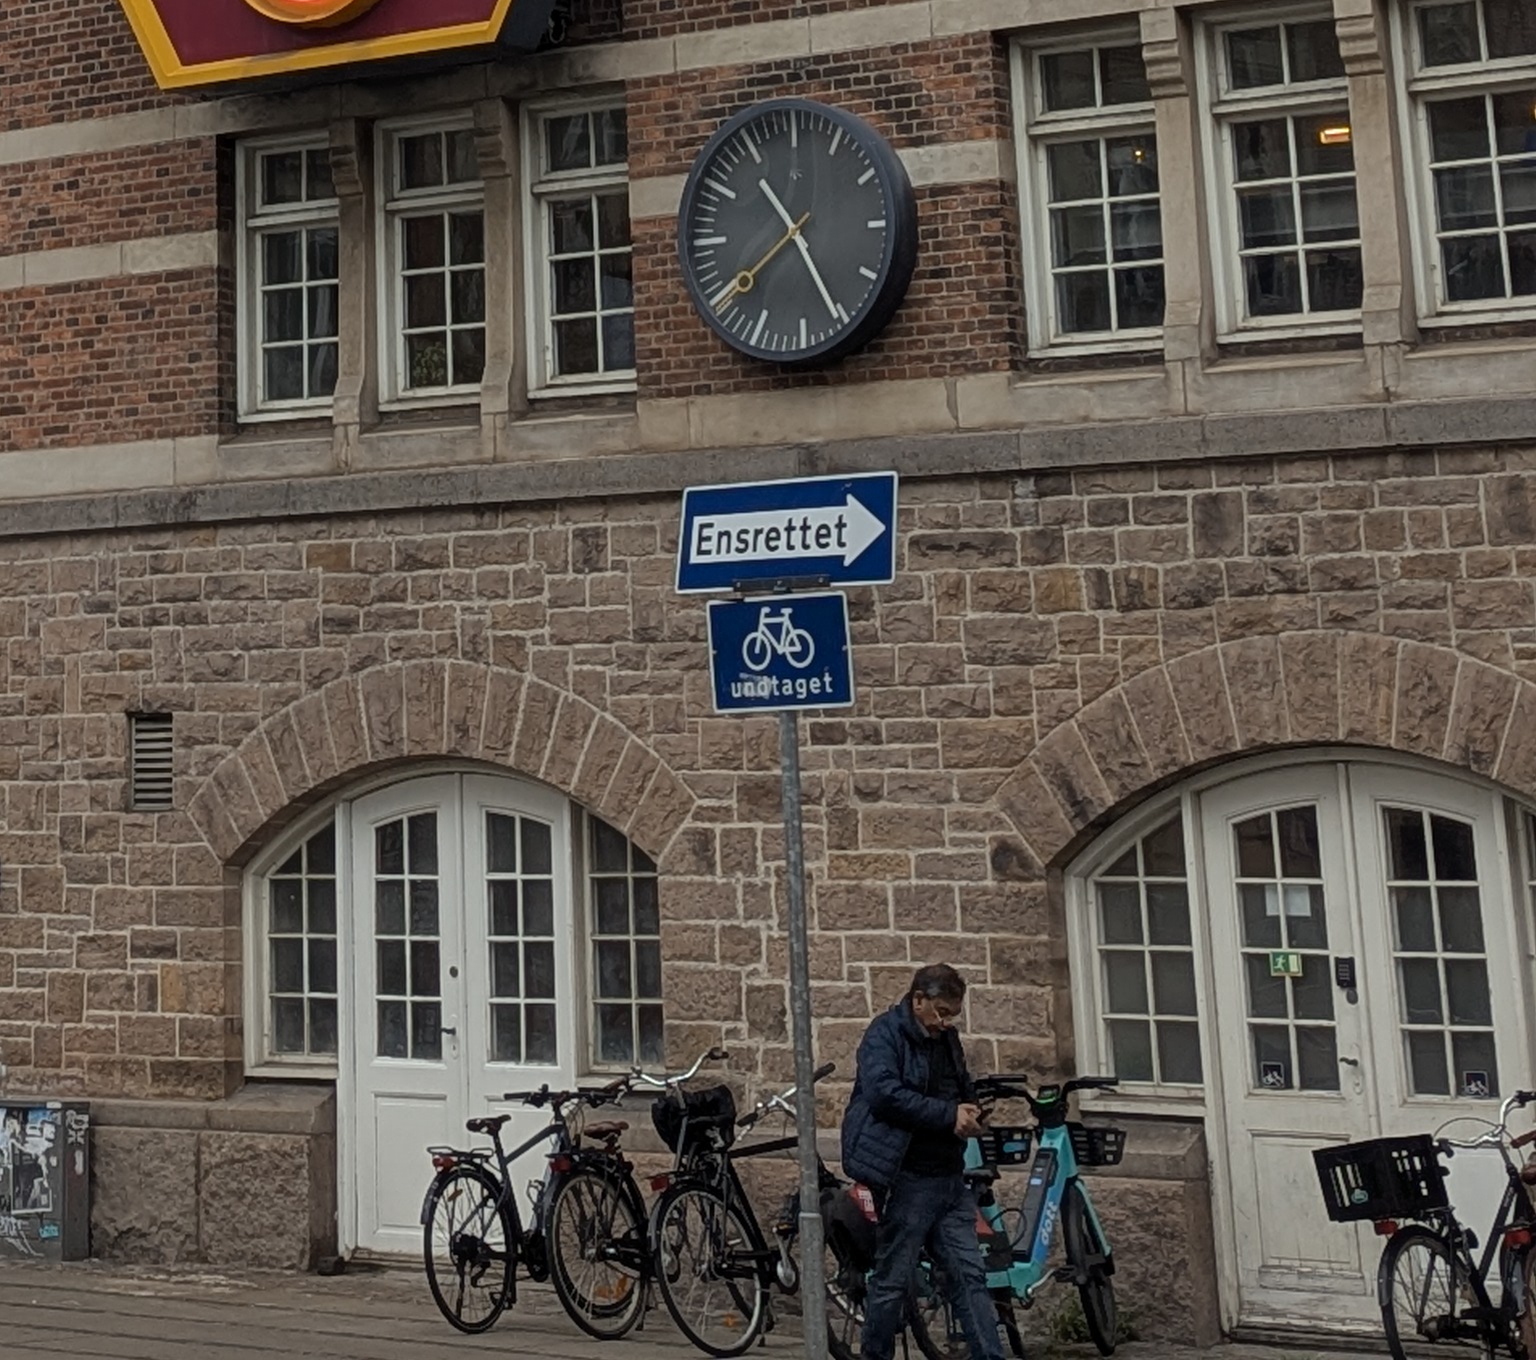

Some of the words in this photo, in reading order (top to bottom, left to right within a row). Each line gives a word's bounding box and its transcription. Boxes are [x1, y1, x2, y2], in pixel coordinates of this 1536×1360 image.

[696, 515, 847, 556] Ensrettet
[731, 672, 833, 699] undtaget
[1041, 1201, 1058, 1246] dott
